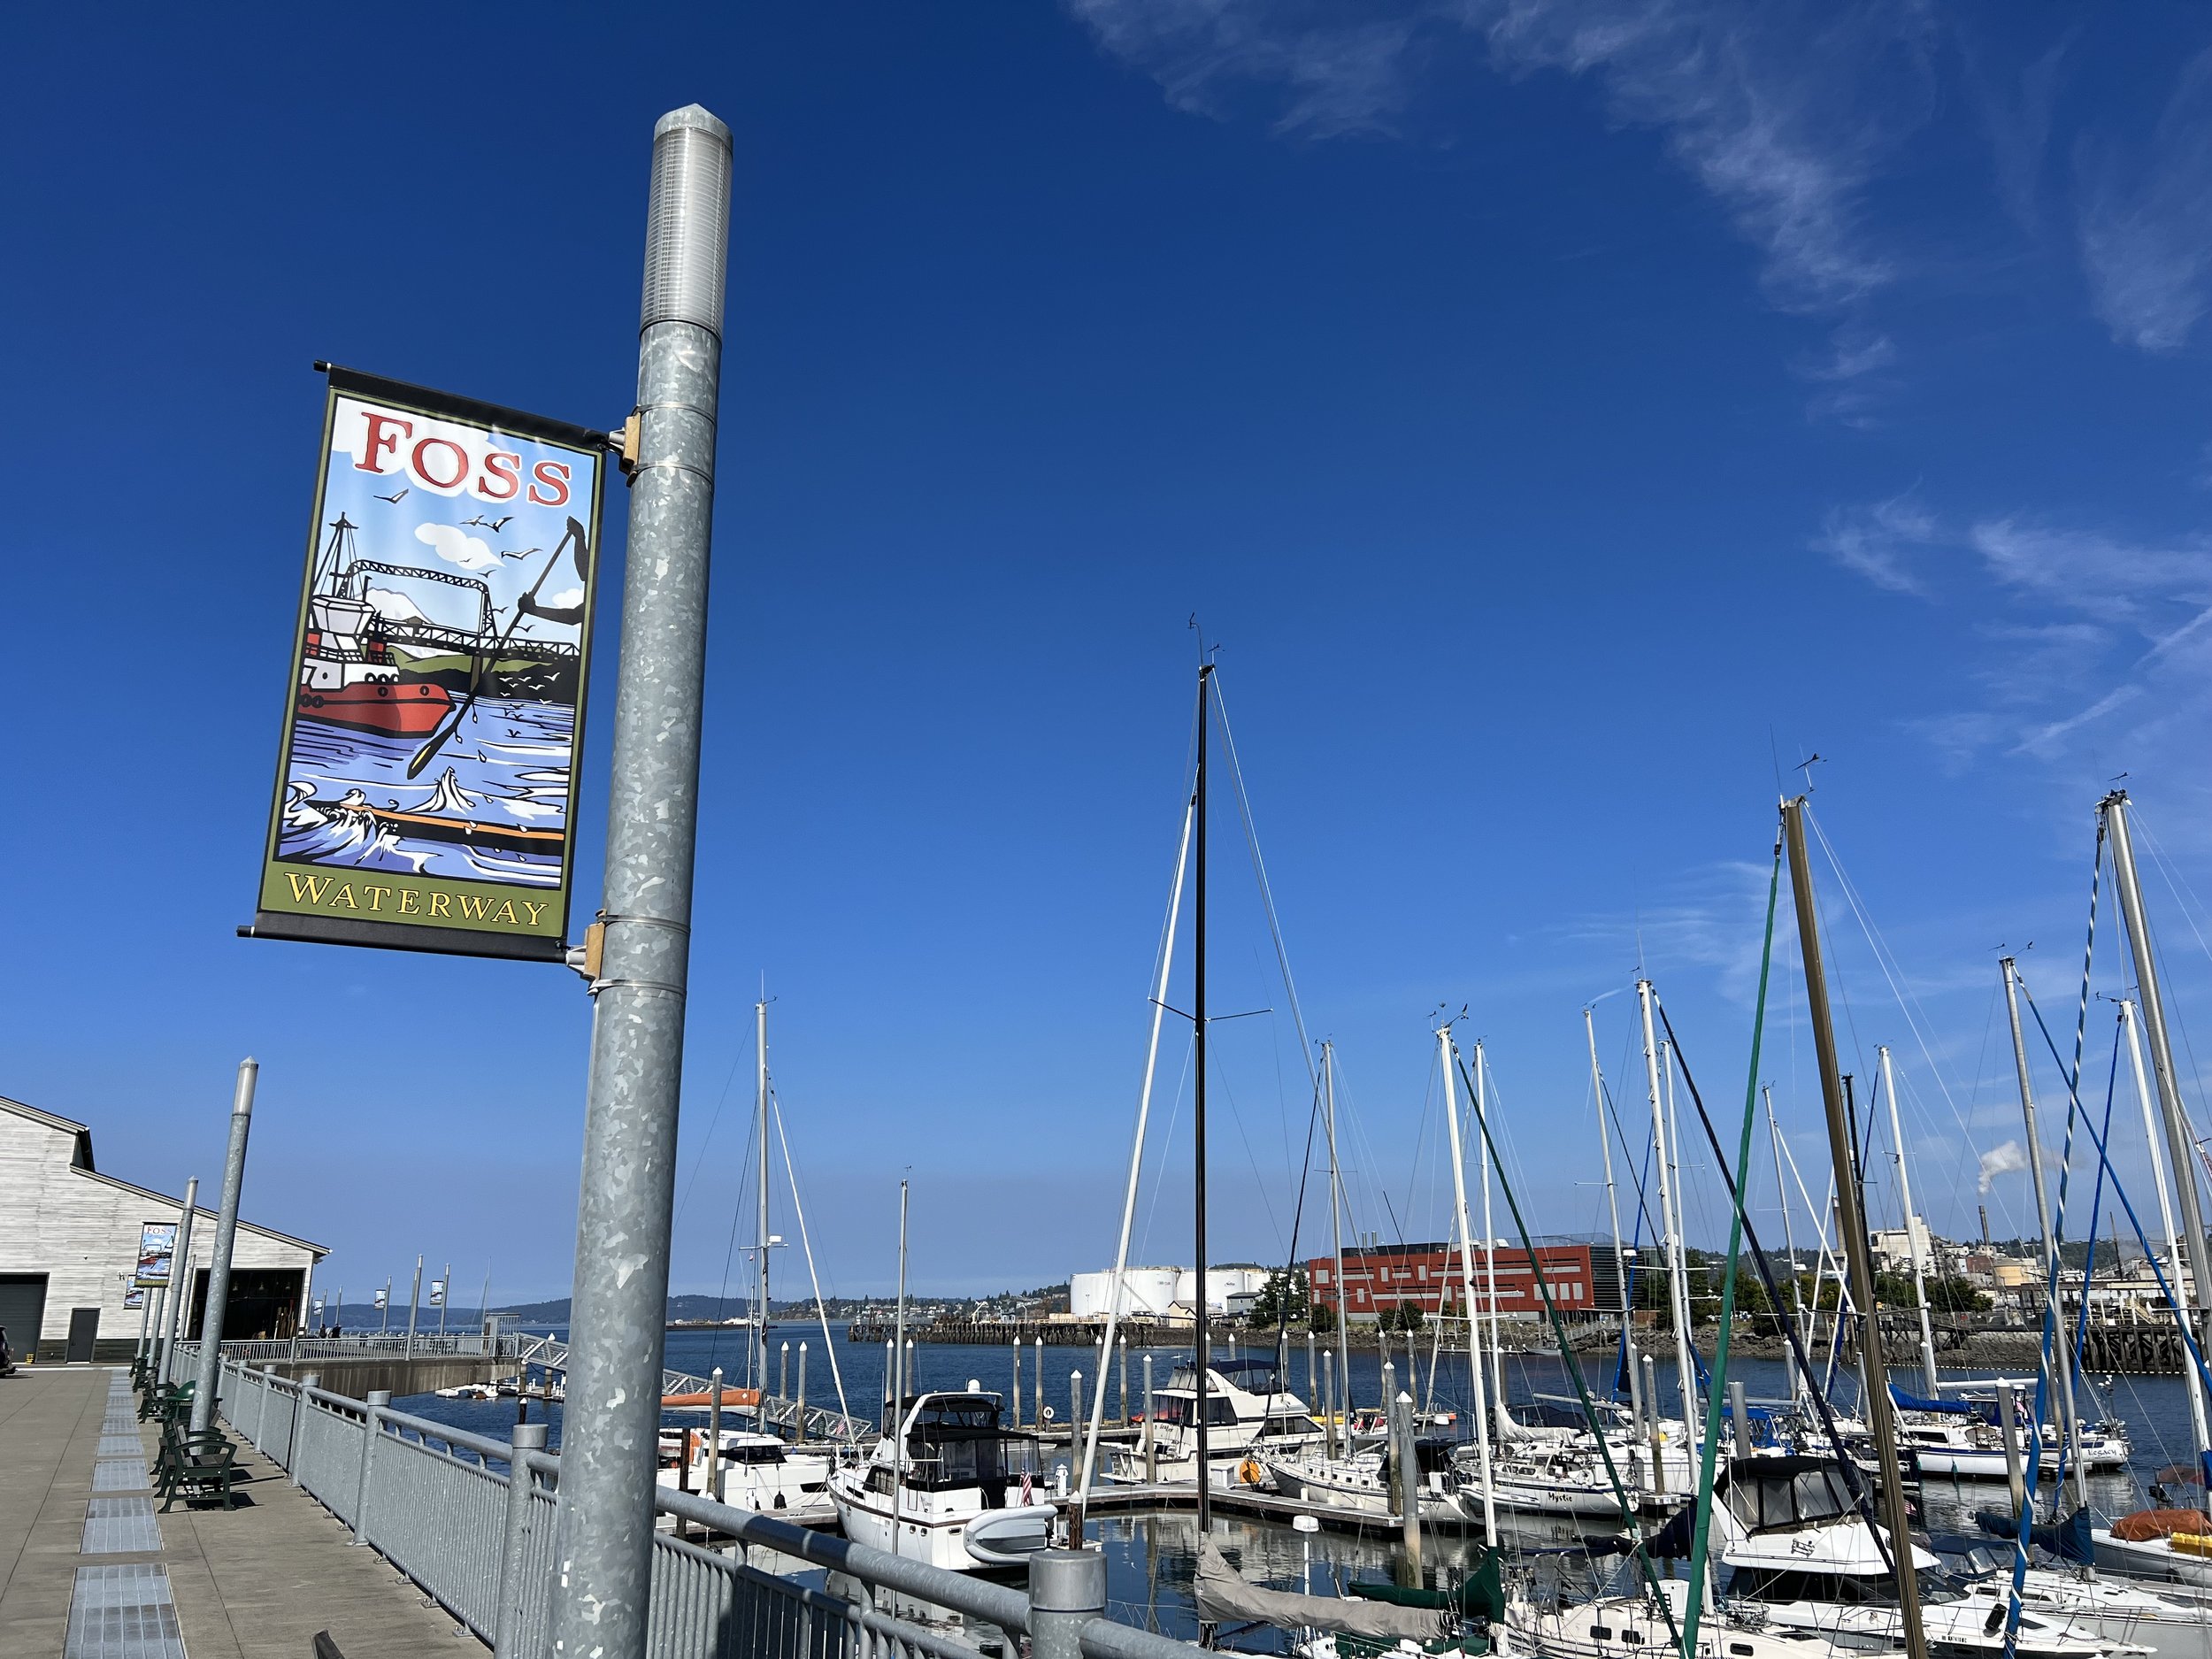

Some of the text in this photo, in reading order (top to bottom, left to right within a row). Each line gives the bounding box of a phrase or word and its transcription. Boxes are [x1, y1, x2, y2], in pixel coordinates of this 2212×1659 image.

[354, 411, 571, 506] FOSS
[284, 872, 549, 926] WATERWAY
[1548, 1492, 1572, 1502] Mystic
